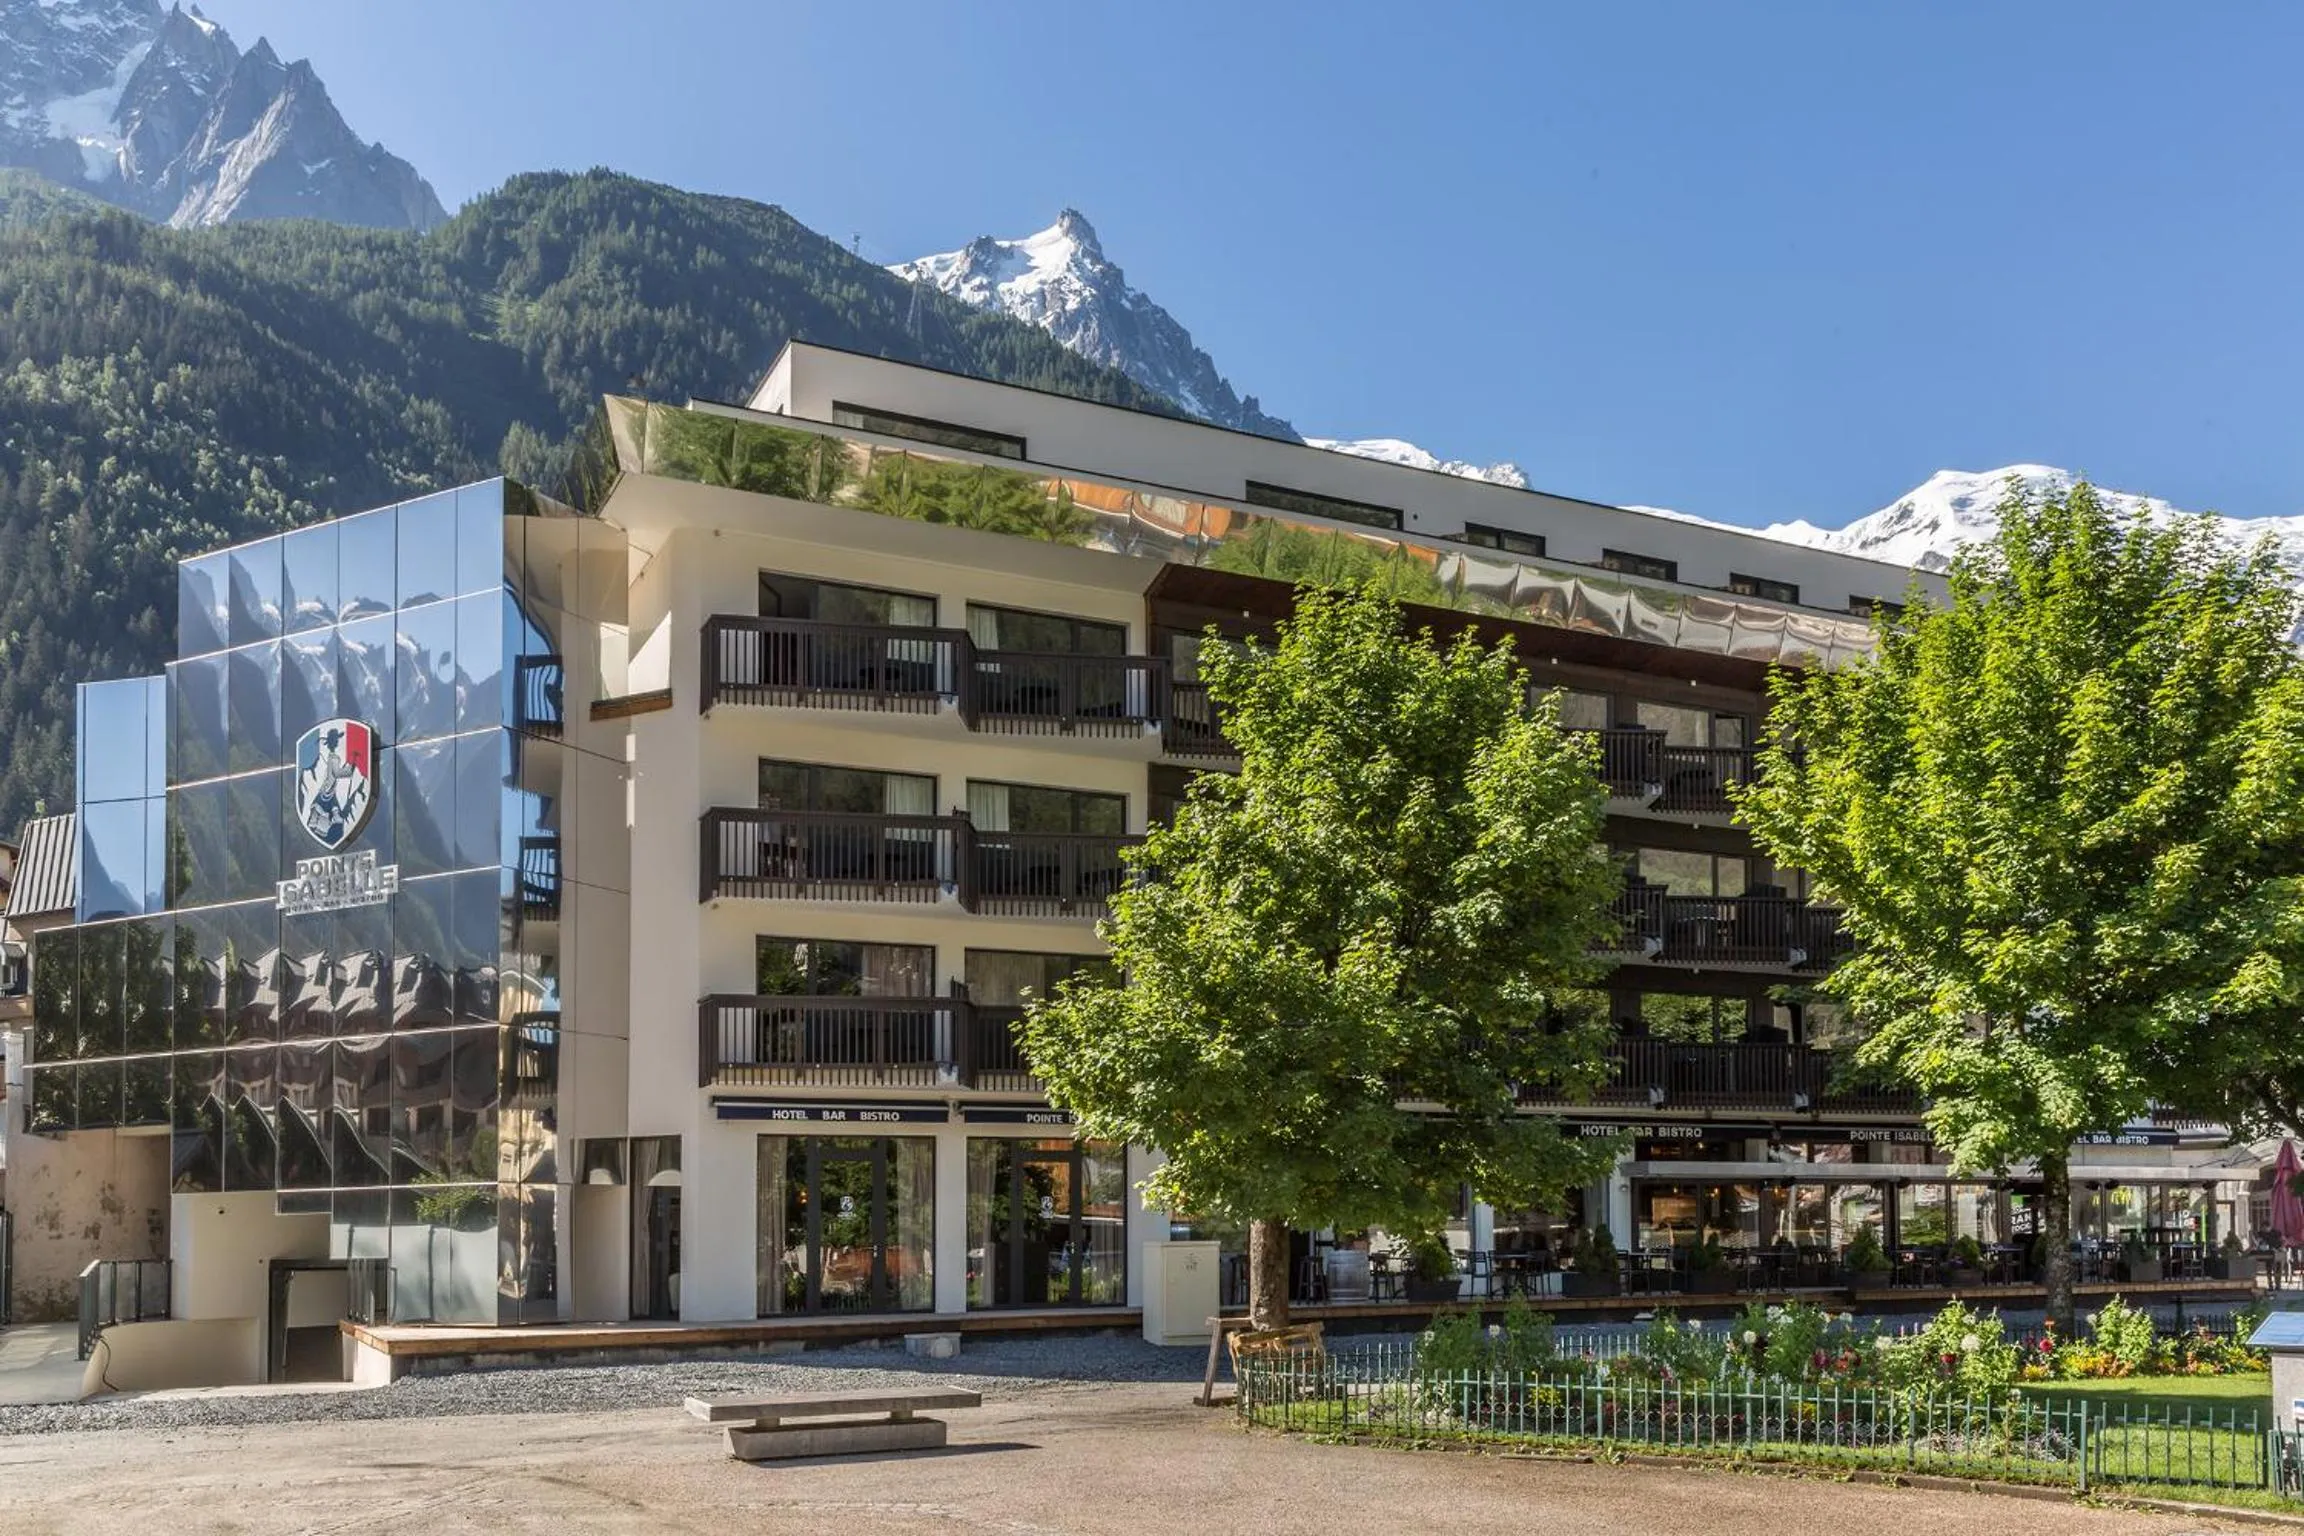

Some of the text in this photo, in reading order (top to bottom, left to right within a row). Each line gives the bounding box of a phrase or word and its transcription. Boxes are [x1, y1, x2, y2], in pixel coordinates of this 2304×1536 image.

[297, 852, 374, 879] POINTE
[772, 1109, 900, 1122] HOTEL BAR BISTRO
[1027, 1113, 1063, 1124] POINTE
[1581, 1125, 1619, 1136] HOTEL
[1658, 1127, 1703, 1138] BISTRO
[1850, 1130, 1934, 1141] POINTE ISABEL
[2093, 1134, 2112, 1144] BAR
